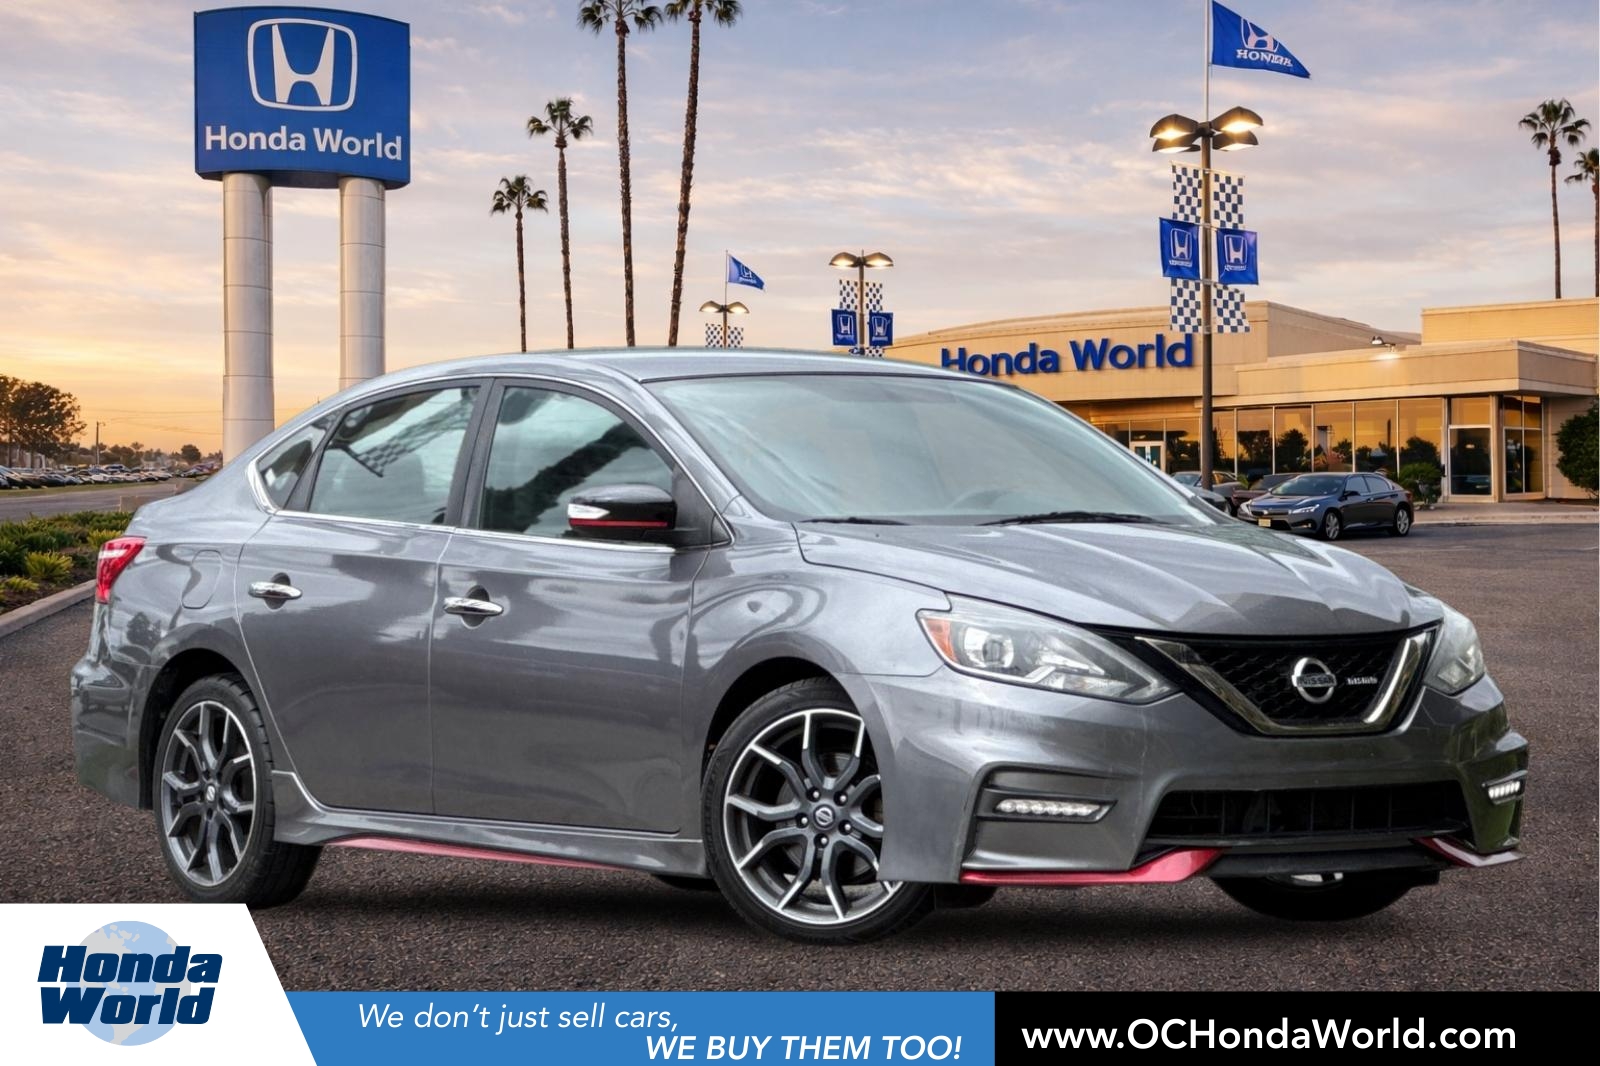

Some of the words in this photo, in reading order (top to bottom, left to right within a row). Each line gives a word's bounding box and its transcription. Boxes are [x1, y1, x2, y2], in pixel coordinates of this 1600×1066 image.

[205, 125, 306, 151] Honda
[312, 127, 402, 161] World
[941, 342, 1061, 376] Honda
[1070, 333, 1194, 371] World
